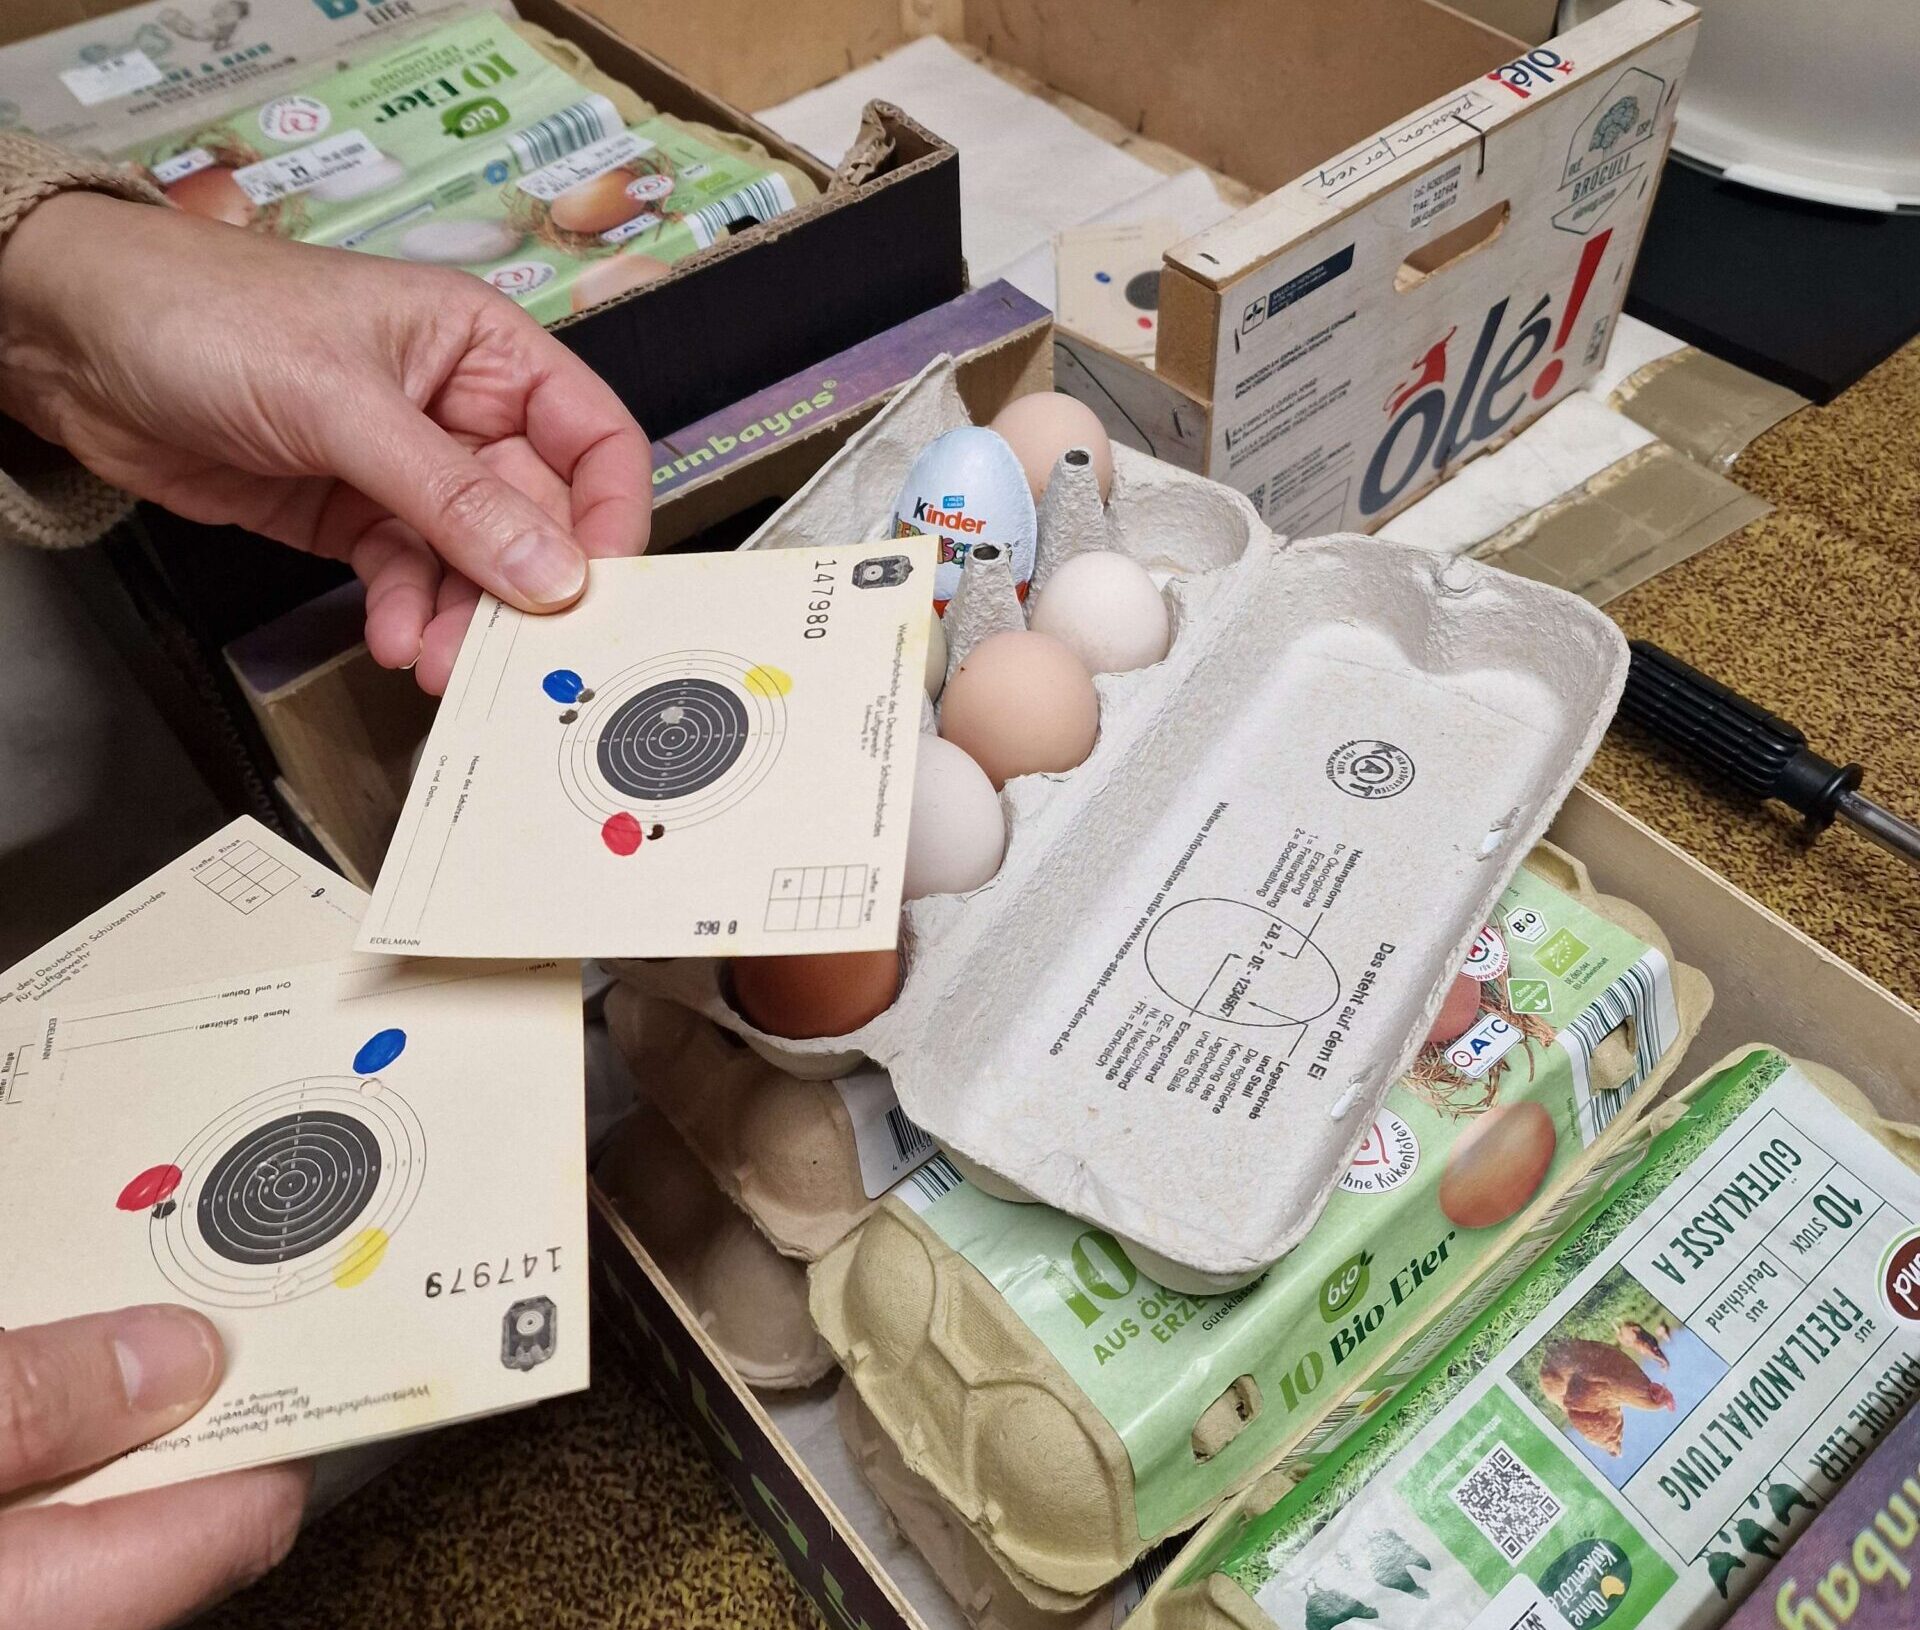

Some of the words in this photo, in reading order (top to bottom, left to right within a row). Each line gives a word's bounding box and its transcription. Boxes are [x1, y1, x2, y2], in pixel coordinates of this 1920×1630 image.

[803, 559, 838, 640] 147980
[1201, 801, 1229, 833] Weitere
[1161, 832, 1208, 892] Informationen
[1255, 841, 1298, 897] Bodenhaltung
[1266, 846, 1312, 908] Freilandhaltung
[1291, 851, 1325, 896] Erzeugung
[1322, 849, 1364, 909] Haltungsform
[1145, 891, 1167, 918] unter
[16, 978, 36, 992] des
[35, 941, 89, 978] Deutschen
[89, 890, 167, 942] Schützenbundes
[369, 936, 421, 947] EDELMANN
[1370, 942, 1397, 969] Das
[15, 992, 33, 1004] für
[34, 951, 92, 993] Luftgewehr
[255, 985, 272, 995] und
[276, 981, 291, 990] Ort
[1219, 976, 1252, 1018] 1234567
[1349, 970, 1377, 1006] steht
[243, 1013, 259, 1023] des
[263, 1008, 290, 1019] Name
[1336, 1005, 1356, 1031] auf
[42, 1017, 57, 1061] EDELMANN
[1096, 1021, 1133, 1067] Frankreich
[1105, 1027, 1147, 1081] Niederlande
[1145, 1020, 1191, 1084] Erzeugerland
[1183, 1049, 1200, 1067] des
[1195, 1030, 1211, 1049] und
[1242, 1047, 1259, 1065] Die
[1317, 1030, 1344, 1062] dem
[1117, 1034, 1161, 1091] Deutschland
[1166, 1065, 1189, 1093] Stalls
[1185, 1036, 1228, 1094] Legebetriebs
[1210, 1042, 1244, 1083] Kennung
[1255, 1054, 1273, 1073] und
[1306, 1063, 1328, 1081] Ei
[1200, 1083, 1215, 1102] des
[1212, 1065, 1247, 1115] registrierte
[1241, 1074, 1262, 1099] Stall
[1248, 1060, 1290, 1120] Legebetrieb
[1343, 1172, 1373, 1190] hne
[1374, 1121, 1415, 1188] Kükentöten
[1669, 1138, 1802, 1270] GÜTEKLASSE
[1813, 1183, 1863, 1229] 10
[1789, 1217, 1828, 1255] STÜCK
[425, 1246, 562, 1298] 147979
[1327, 1264, 1359, 1306] bio
[1651, 1252, 1686, 1285] A
[1705, 1260, 1778, 1334] Deutschland
[1745, 1299, 1769, 1323] aus
[1092, 1318, 1141, 1366] AUS
[1278, 1351, 1324, 1414] 10
[1329, 1231, 1456, 1367] Bio-Eier
[1854, 1318, 1877, 1344] aus
[1657, 1287, 1863, 1511] FREILANDHALTUNG
[1808, 1425, 1867, 1483] EIER
[1568, 1589, 1609, 1627] Ohne
